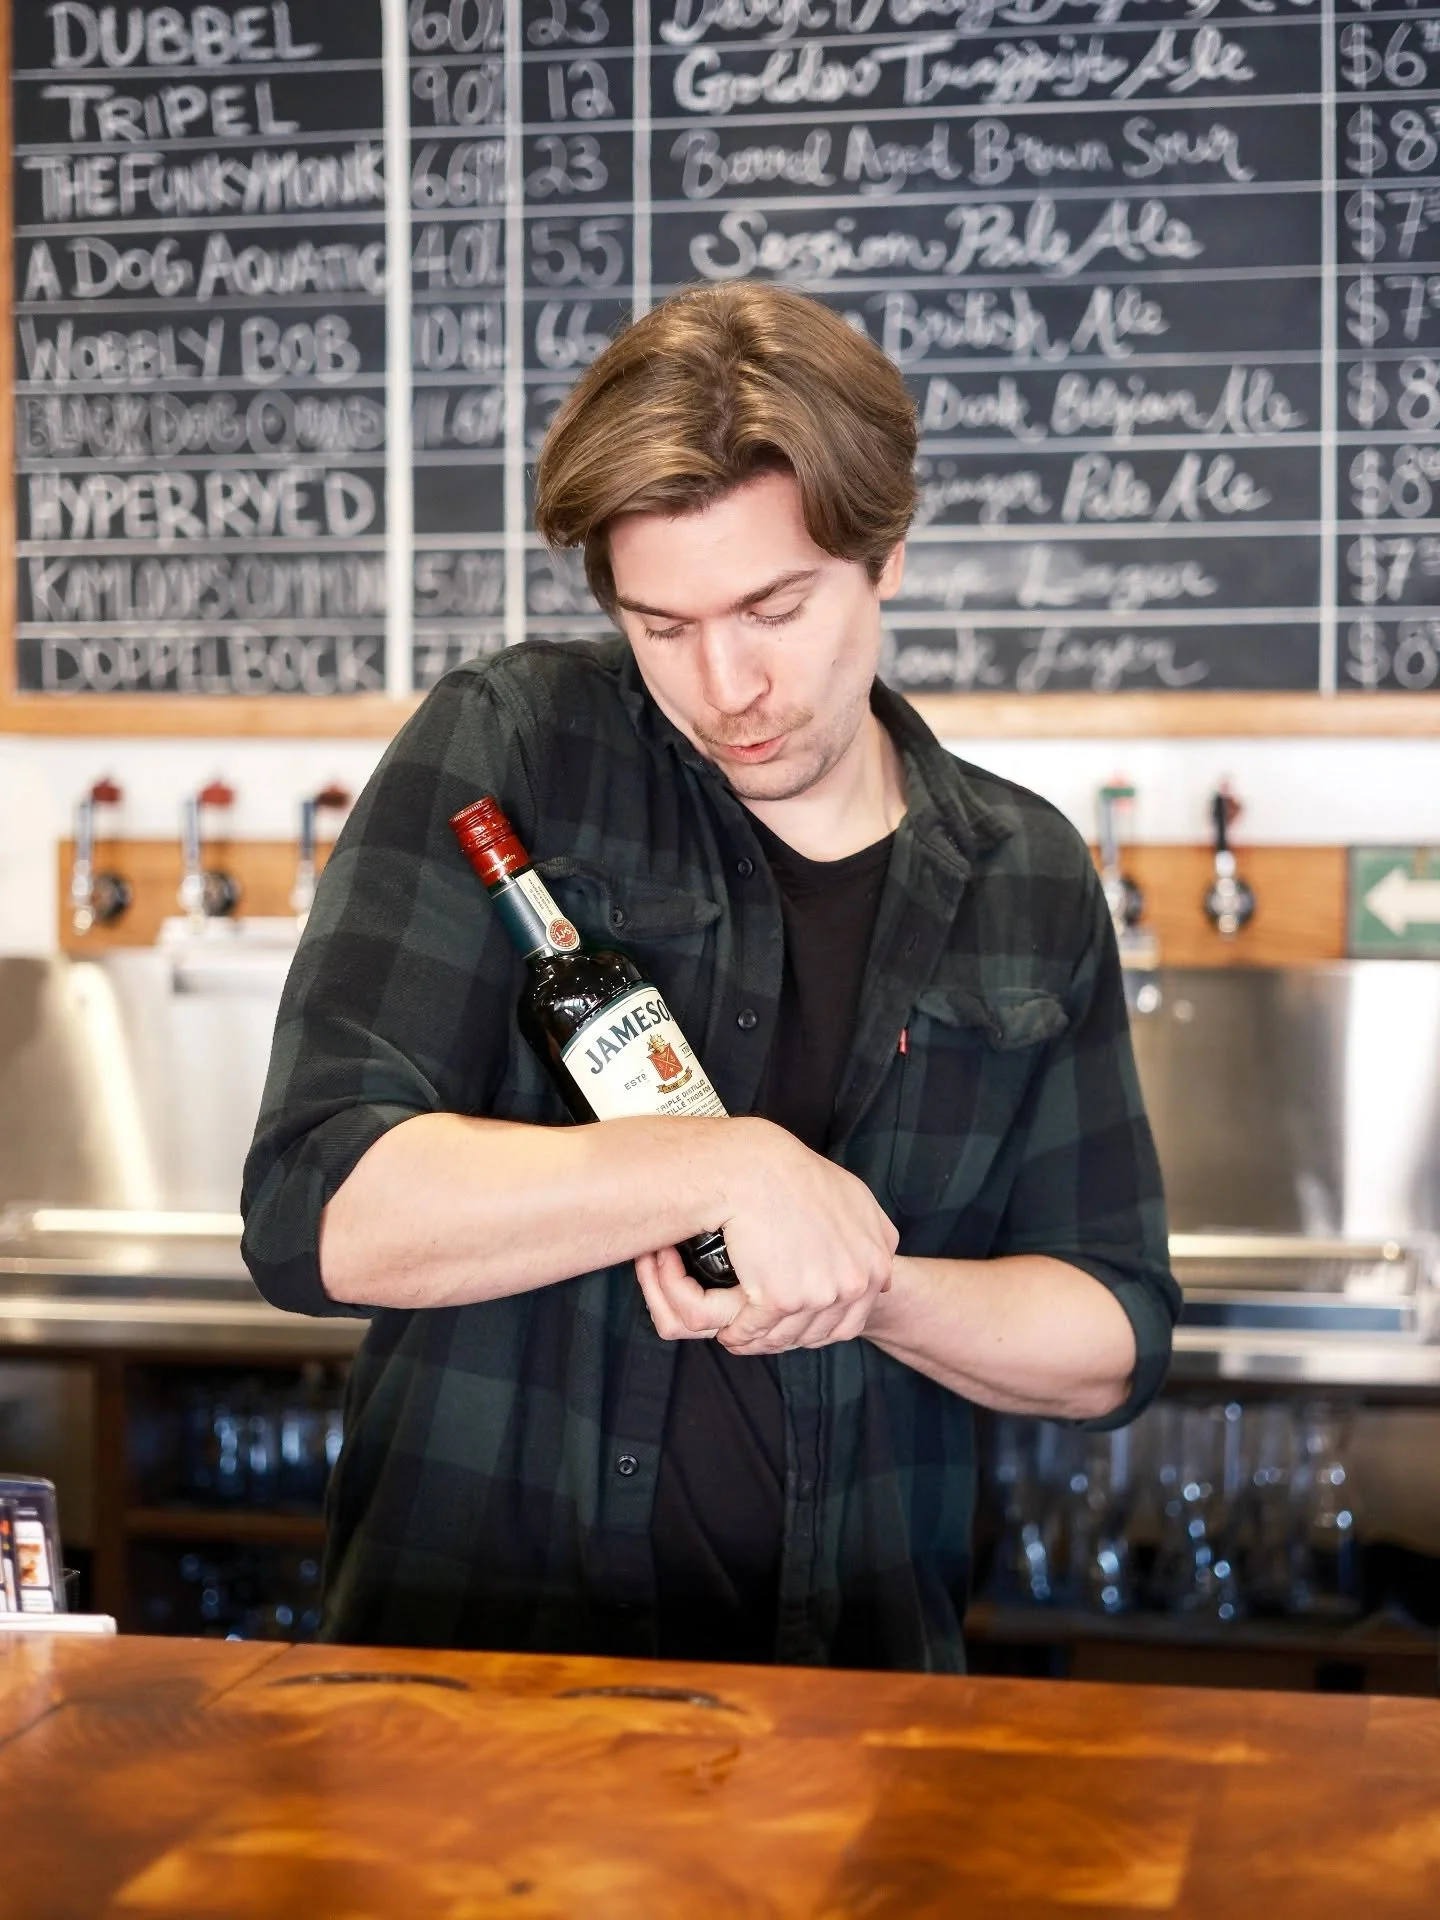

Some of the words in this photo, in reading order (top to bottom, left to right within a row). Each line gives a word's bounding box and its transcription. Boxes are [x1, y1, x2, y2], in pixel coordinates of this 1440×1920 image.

[50, 0, 322, 67] DUBBEL
[41, 80, 300, 142] TRIPEL
[547, 60, 616, 121] 12
[526, 135, 609, 198] 23
[24, 239, 62, 300] A
[530, 216, 628, 288] 55
[19, 315, 226, 385] WOBBLY
[240, 314, 360, 384] BOB
[585, 999, 674, 1075] JAMESO
